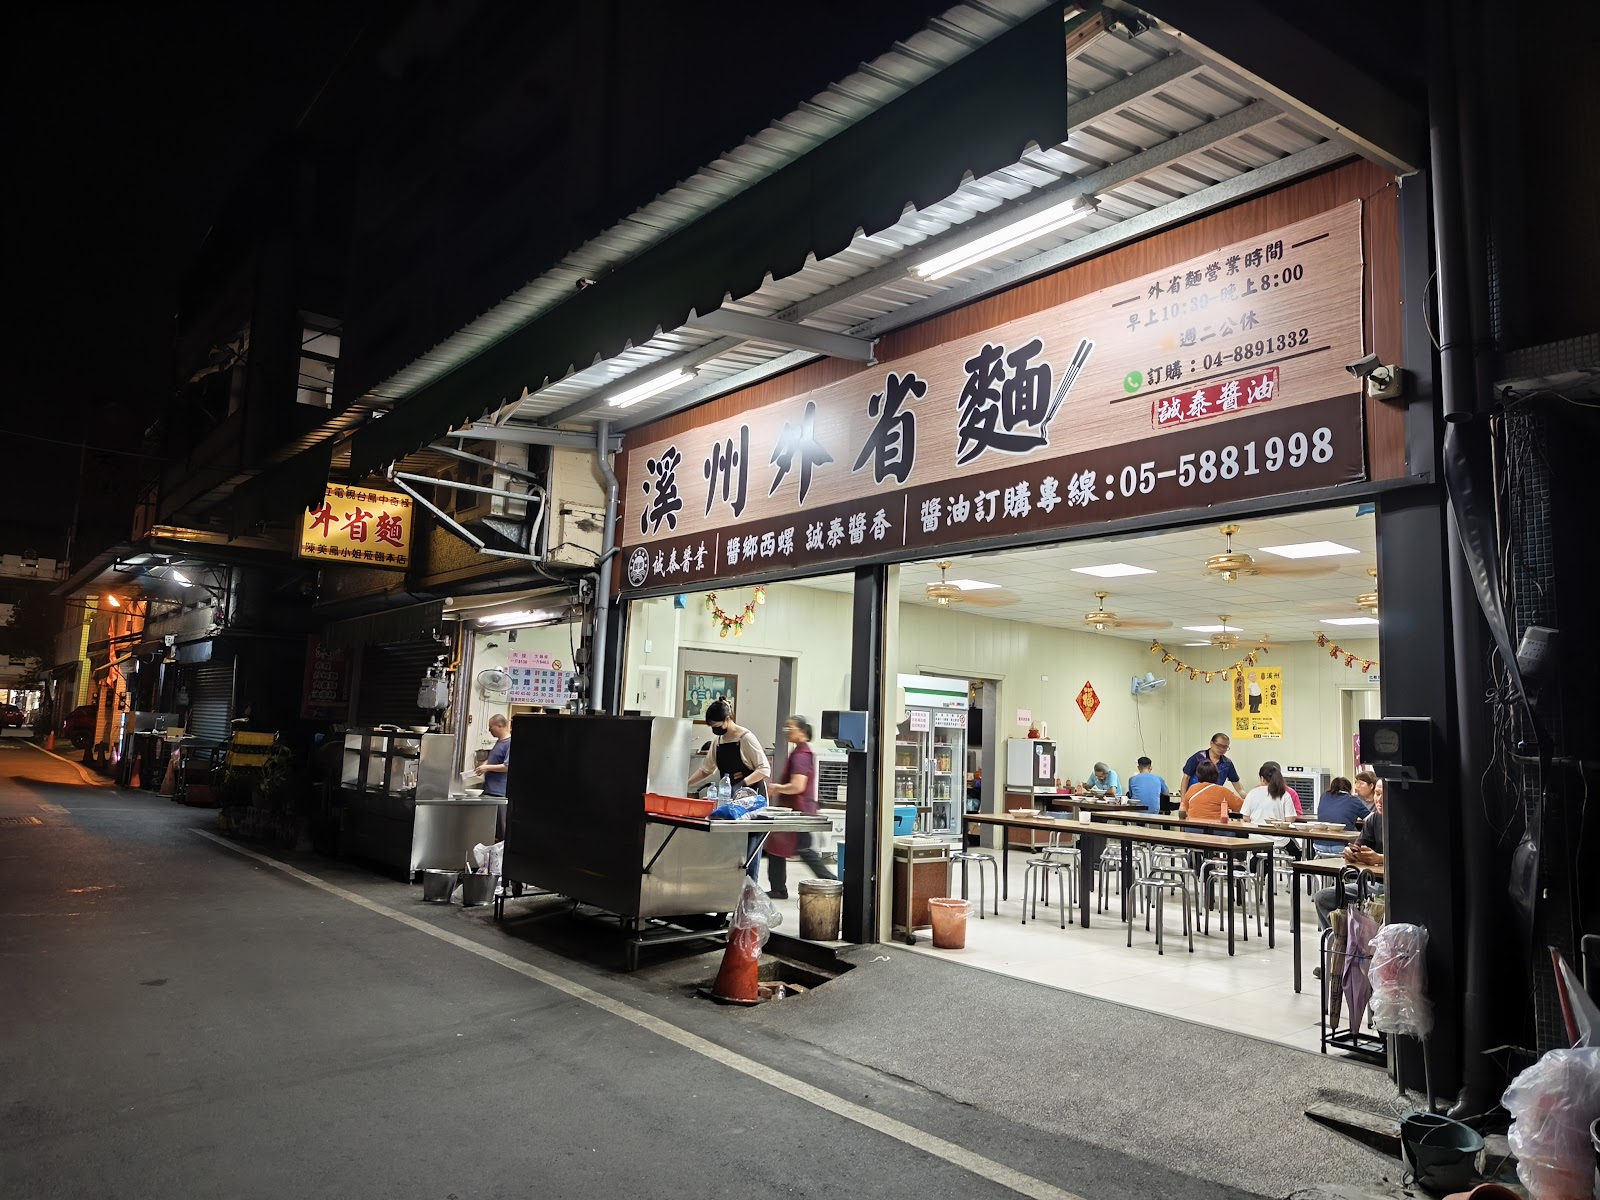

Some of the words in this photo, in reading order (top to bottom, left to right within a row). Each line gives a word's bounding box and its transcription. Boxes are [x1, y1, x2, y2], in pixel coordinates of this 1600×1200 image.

[1148, 239, 1284, 299] 外省麵營業時間
[1179, 310, 1260, 347] 週二公休
[1158, 379, 1275, 423] 誠泰醬油
[640, 337, 1053, 536] 溪州外省麵
[309, 502, 405, 548] 外省麵
[806, 507, 893, 551] 誠泰醬香
